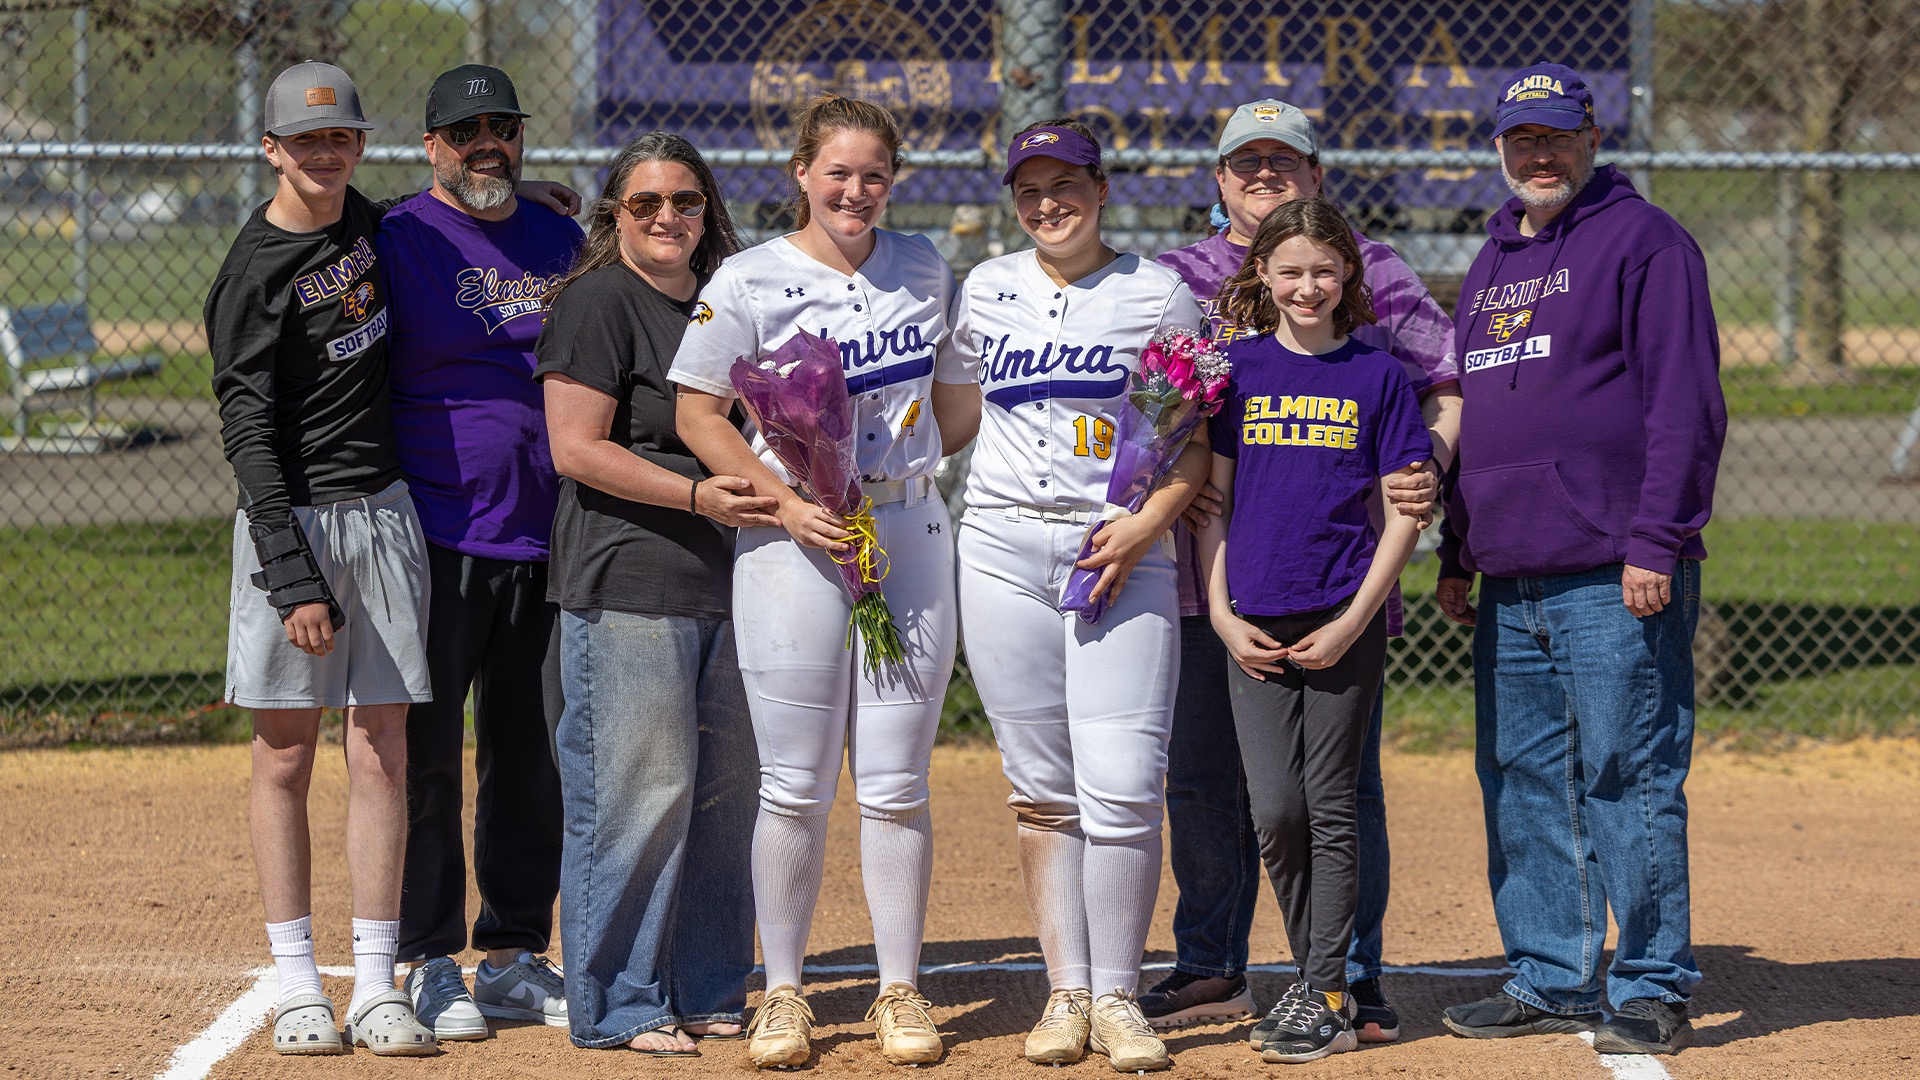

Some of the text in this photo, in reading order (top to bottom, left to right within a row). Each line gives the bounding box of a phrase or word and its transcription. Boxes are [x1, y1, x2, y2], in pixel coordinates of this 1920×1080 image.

[984, 15, 1476, 88] LMIRA
[1504, 75, 1565, 102] ELMIRA
[820, 325, 936, 370] mira
[978, 333, 1131, 386] Elmira
[1467, 339, 1543, 369] SOFTBALL
[1243, 395, 1359, 427] ELMIRA
[1073, 415, 1115, 460] 19
[1242, 422, 1359, 450] COLLEGE
